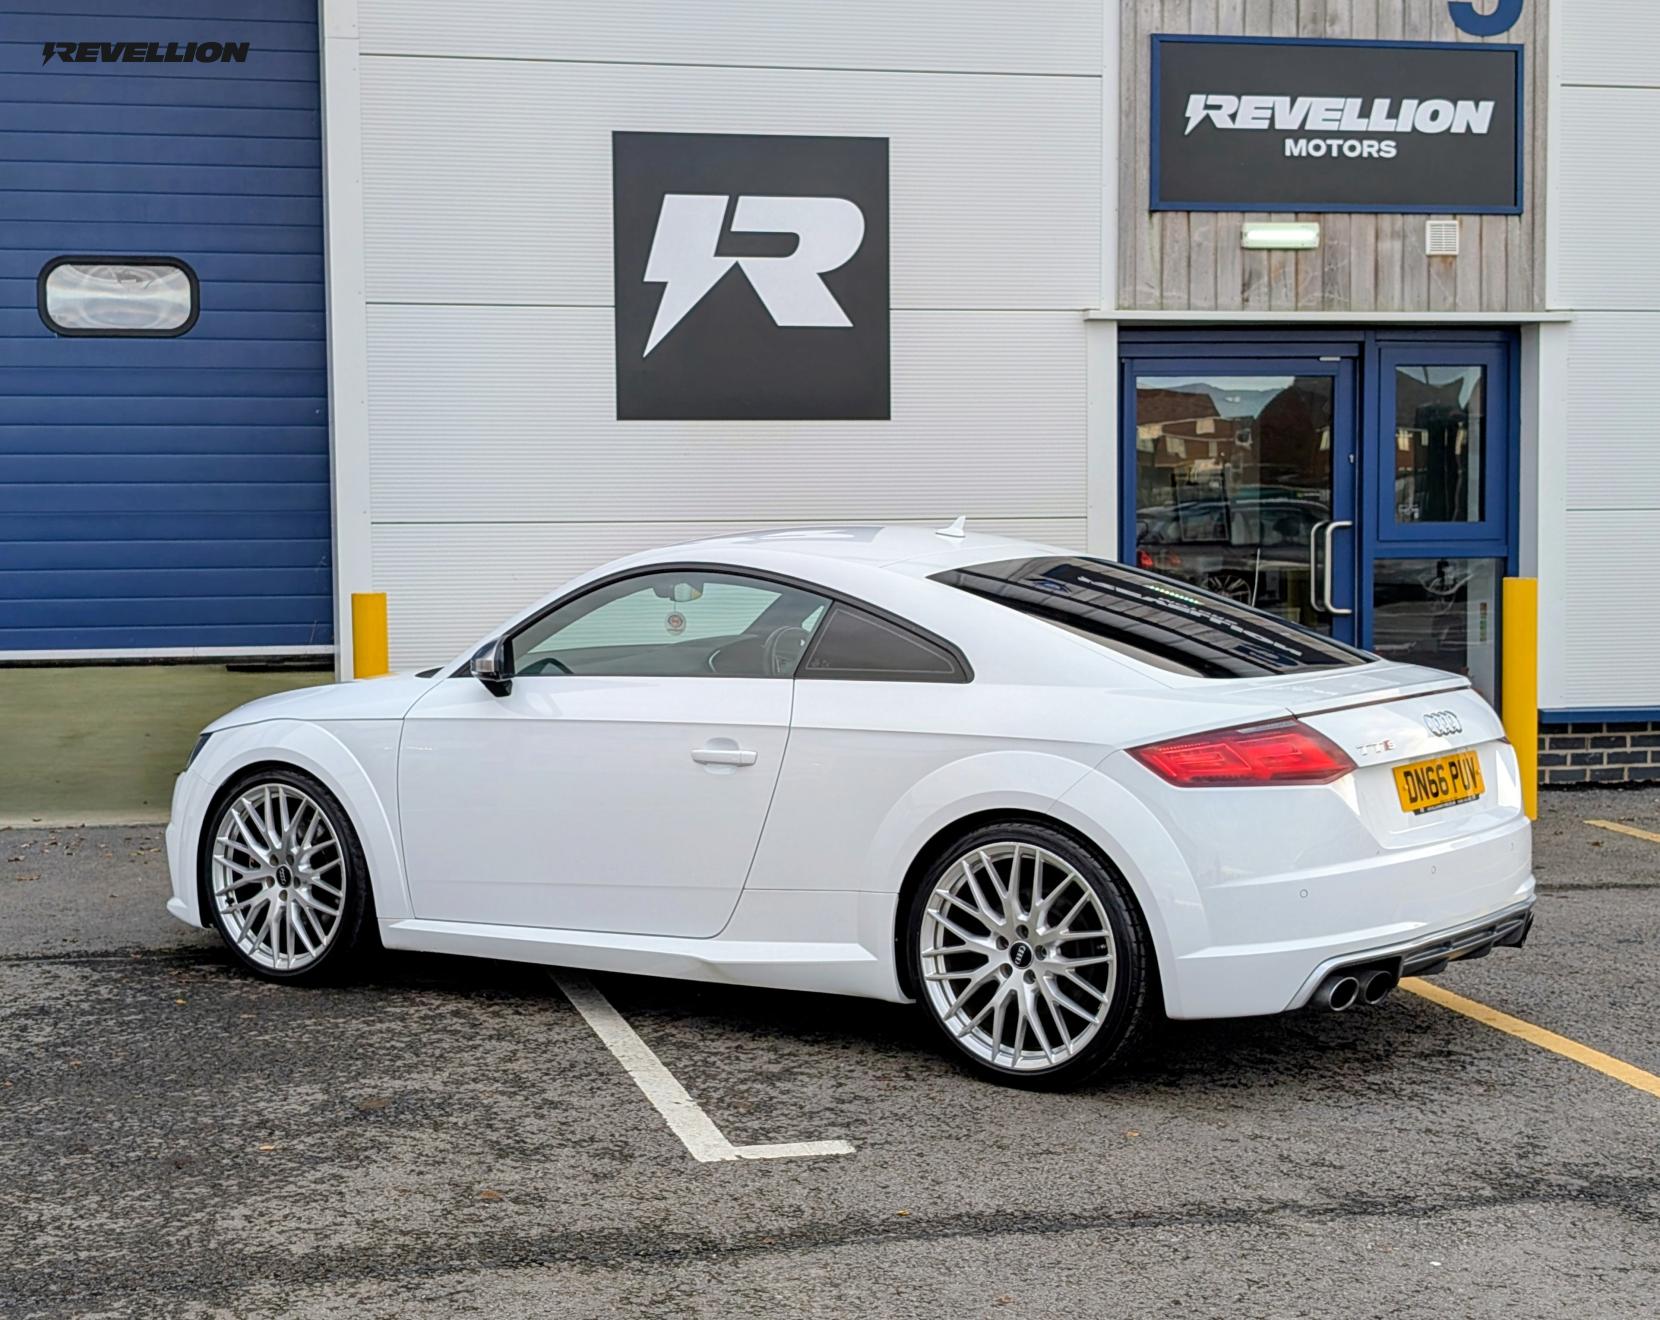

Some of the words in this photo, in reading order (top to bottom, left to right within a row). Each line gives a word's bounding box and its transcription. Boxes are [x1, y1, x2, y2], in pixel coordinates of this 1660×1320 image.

[1184, 94, 1495, 135] REVELLION
[1284, 138, 1397, 158] MOTORS
[1403, 764, 1449, 803] DN66
[1448, 757, 1477, 793] PUV
